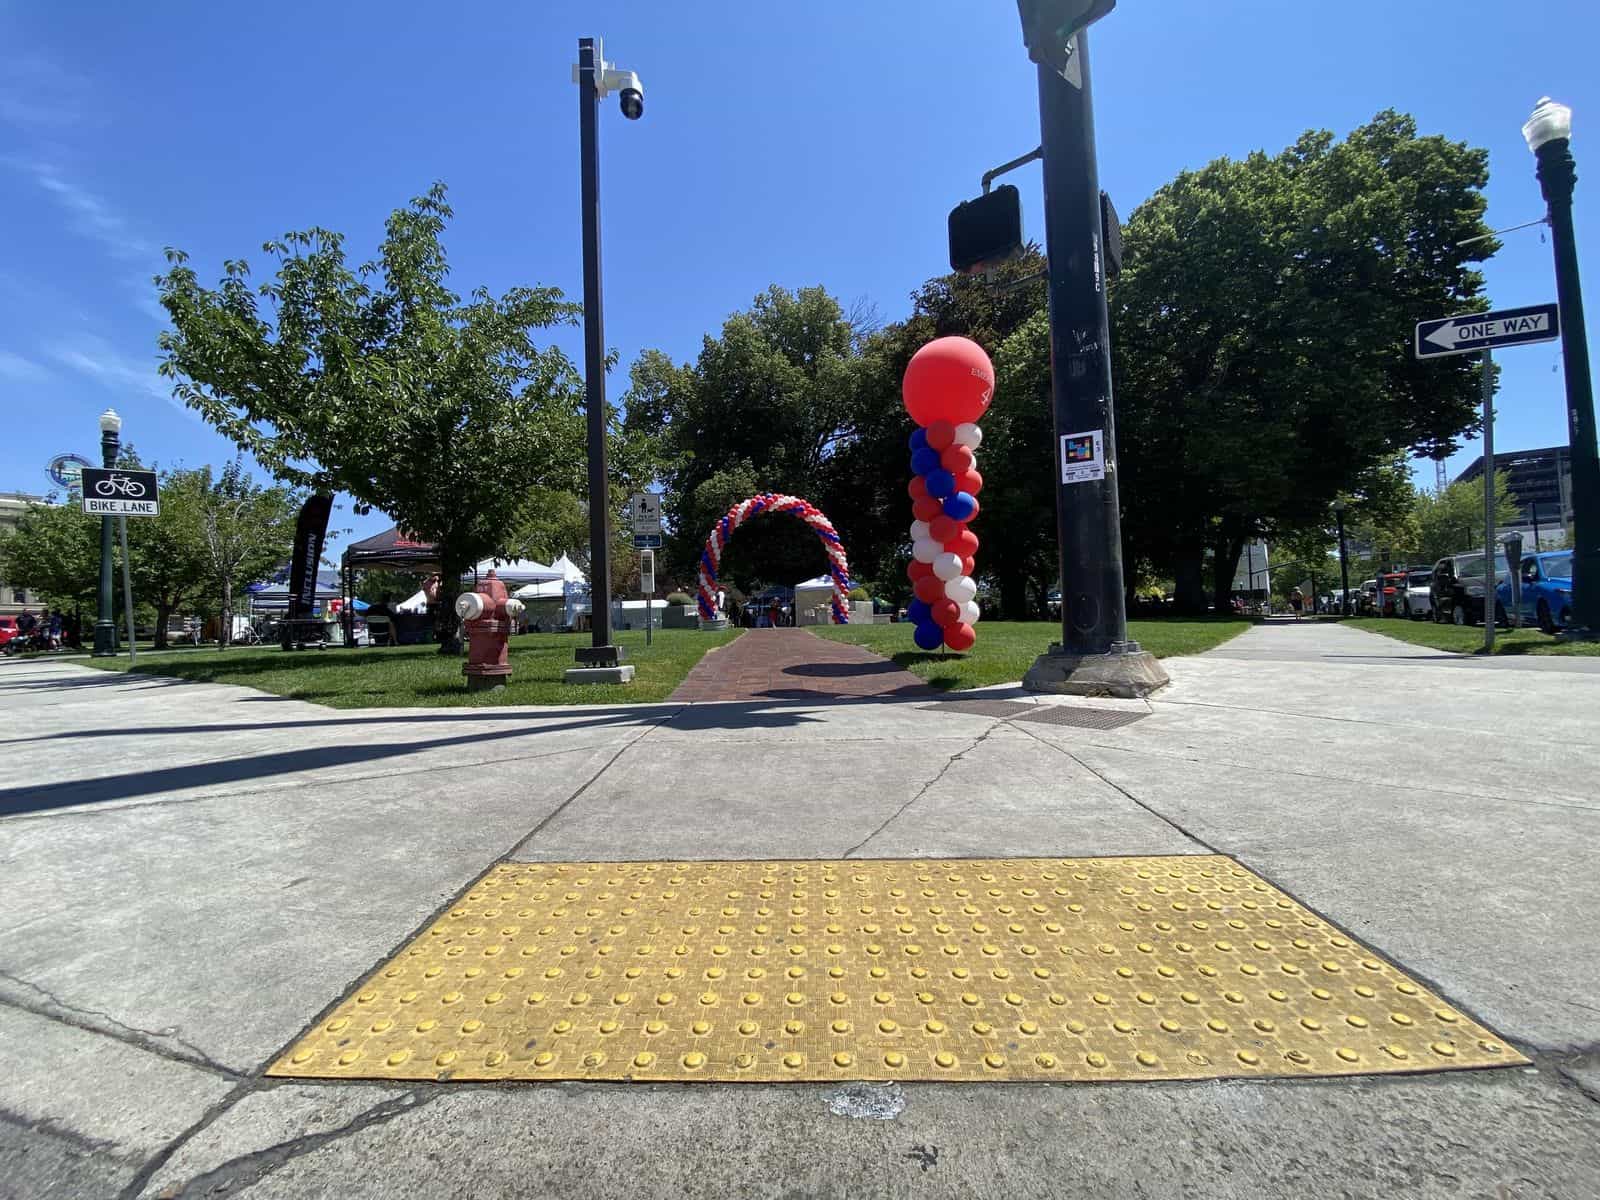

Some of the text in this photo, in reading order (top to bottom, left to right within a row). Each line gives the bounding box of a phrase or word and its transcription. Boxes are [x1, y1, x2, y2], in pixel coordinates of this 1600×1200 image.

[1458, 315, 1542, 340] ONE WAY
[90, 500, 153, 513] BIKE LANE
